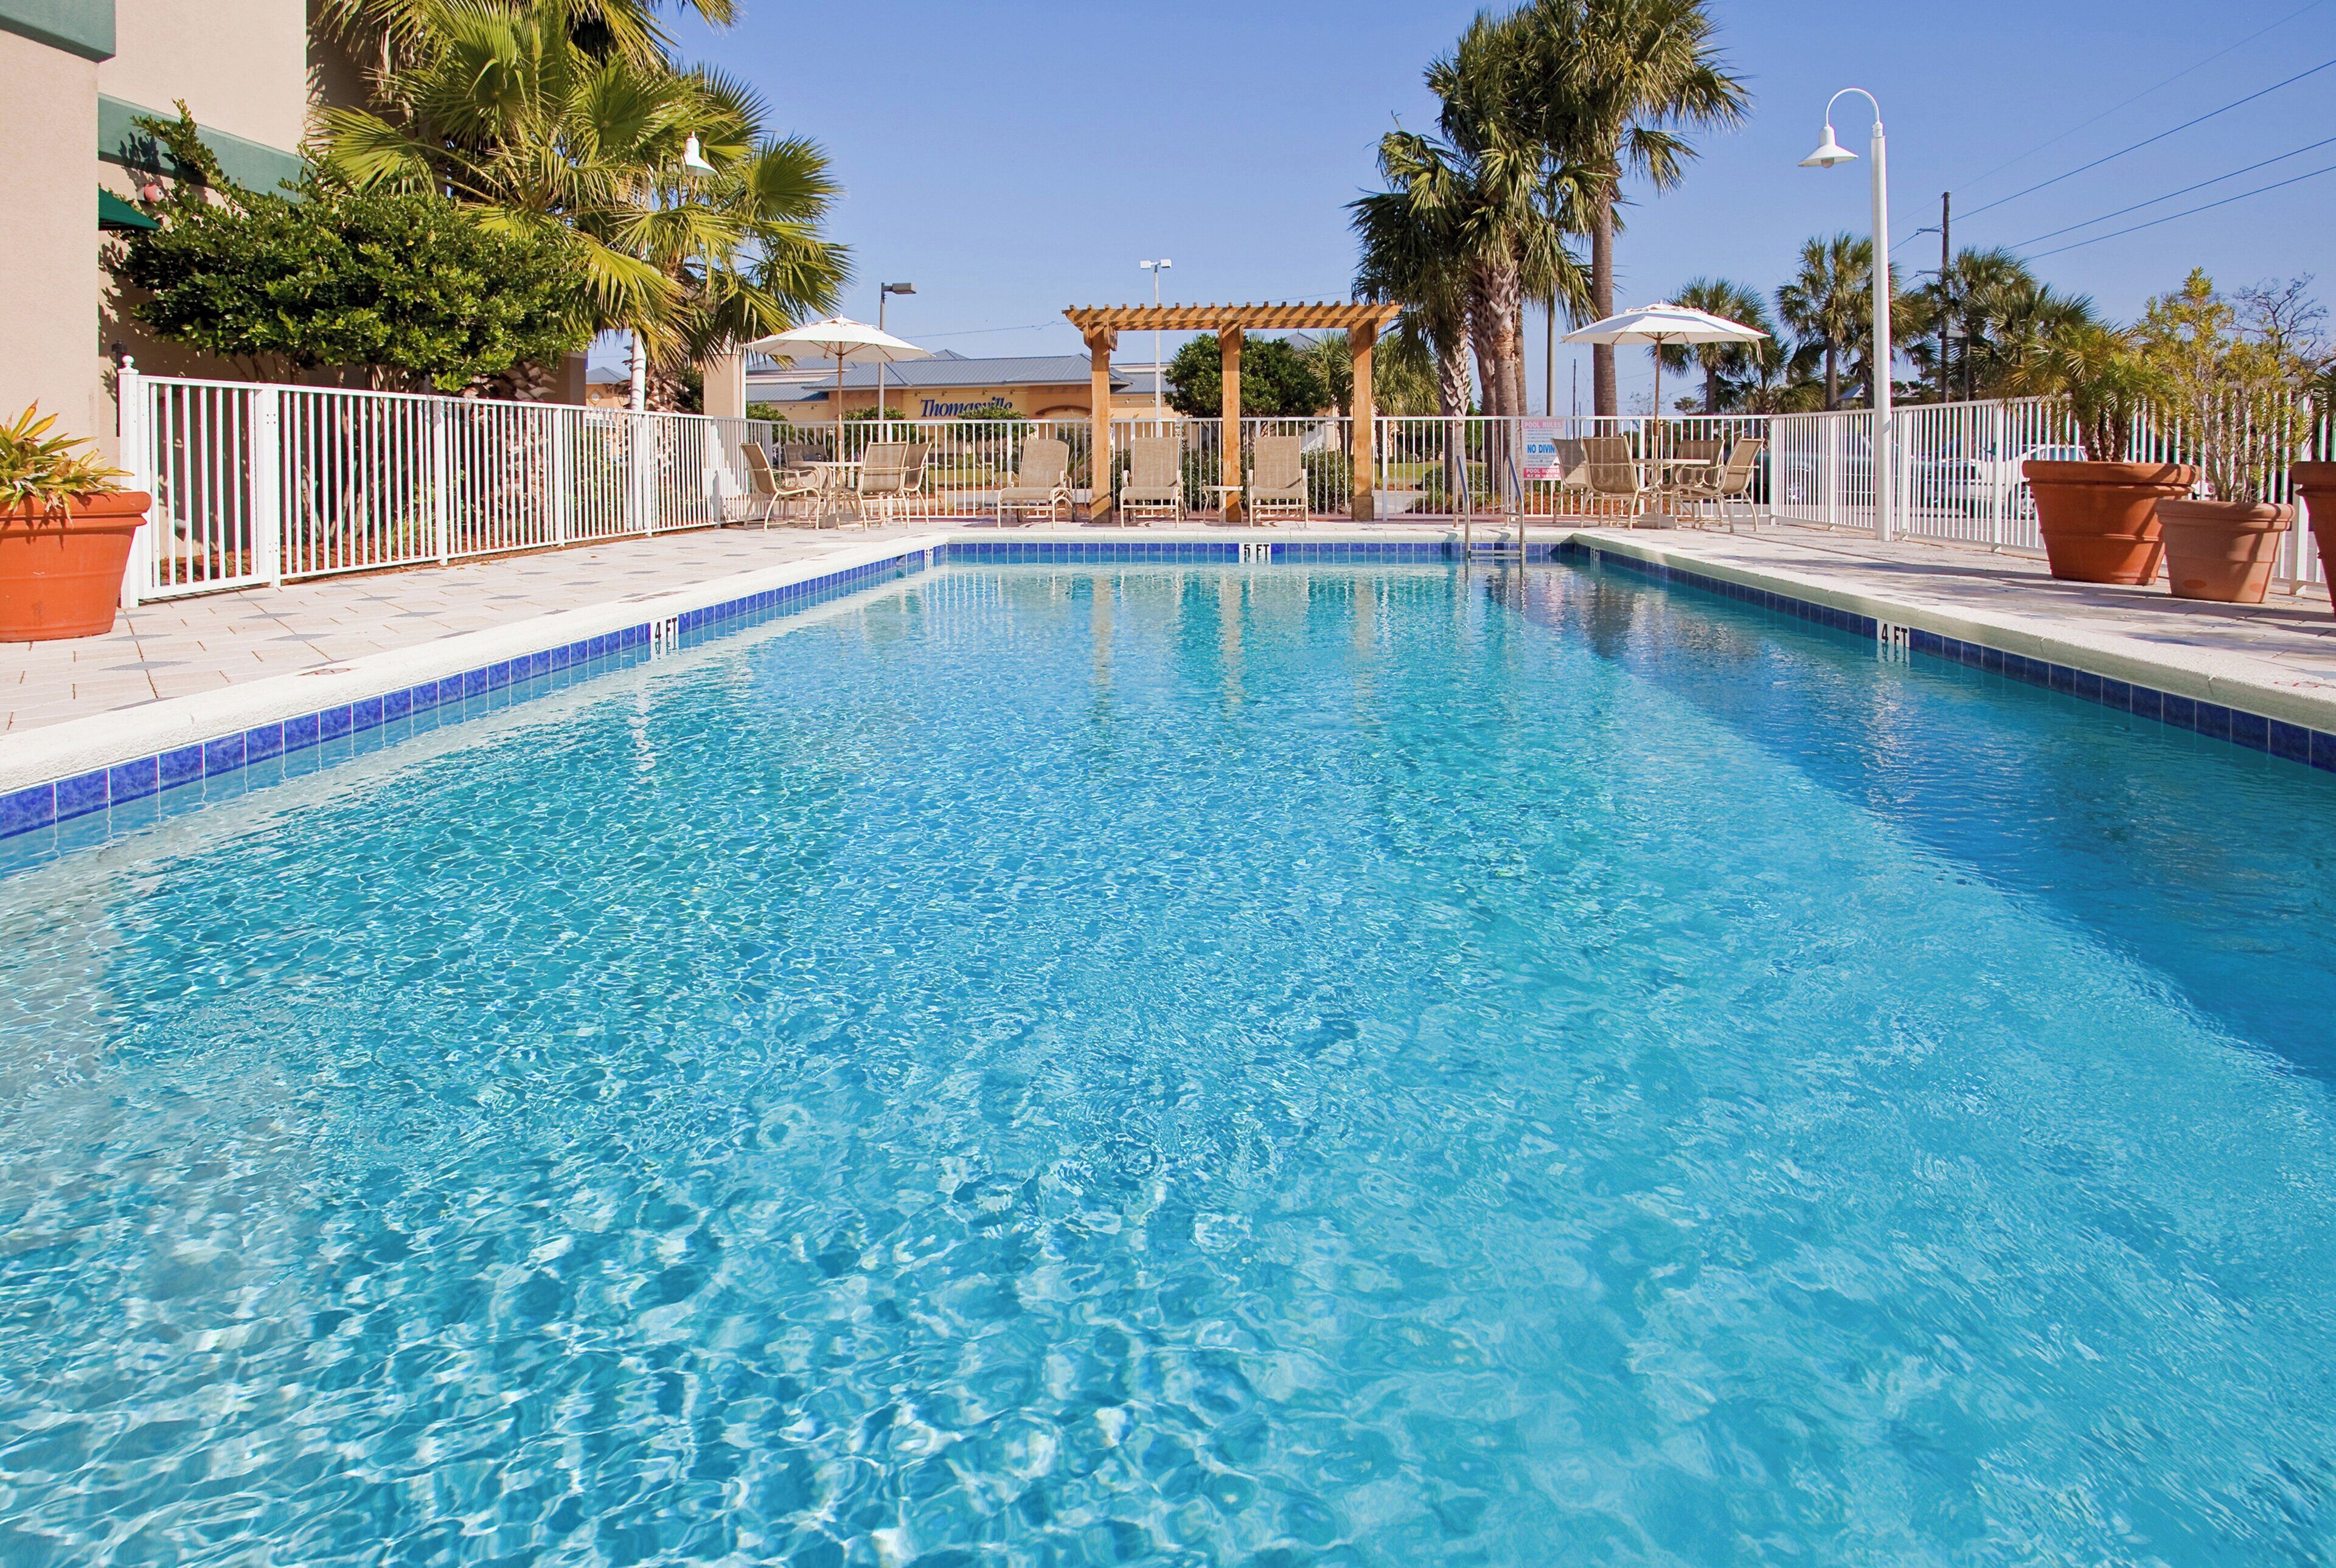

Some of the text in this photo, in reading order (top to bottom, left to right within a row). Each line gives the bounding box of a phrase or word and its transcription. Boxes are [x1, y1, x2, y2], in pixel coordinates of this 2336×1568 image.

[1527, 444, 1556, 453] NO DIVIN
[1243, 544, 1270, 558] 5 FT
[655, 617, 678, 640] 4 FT
[1882, 623, 1908, 647] 4 FT
